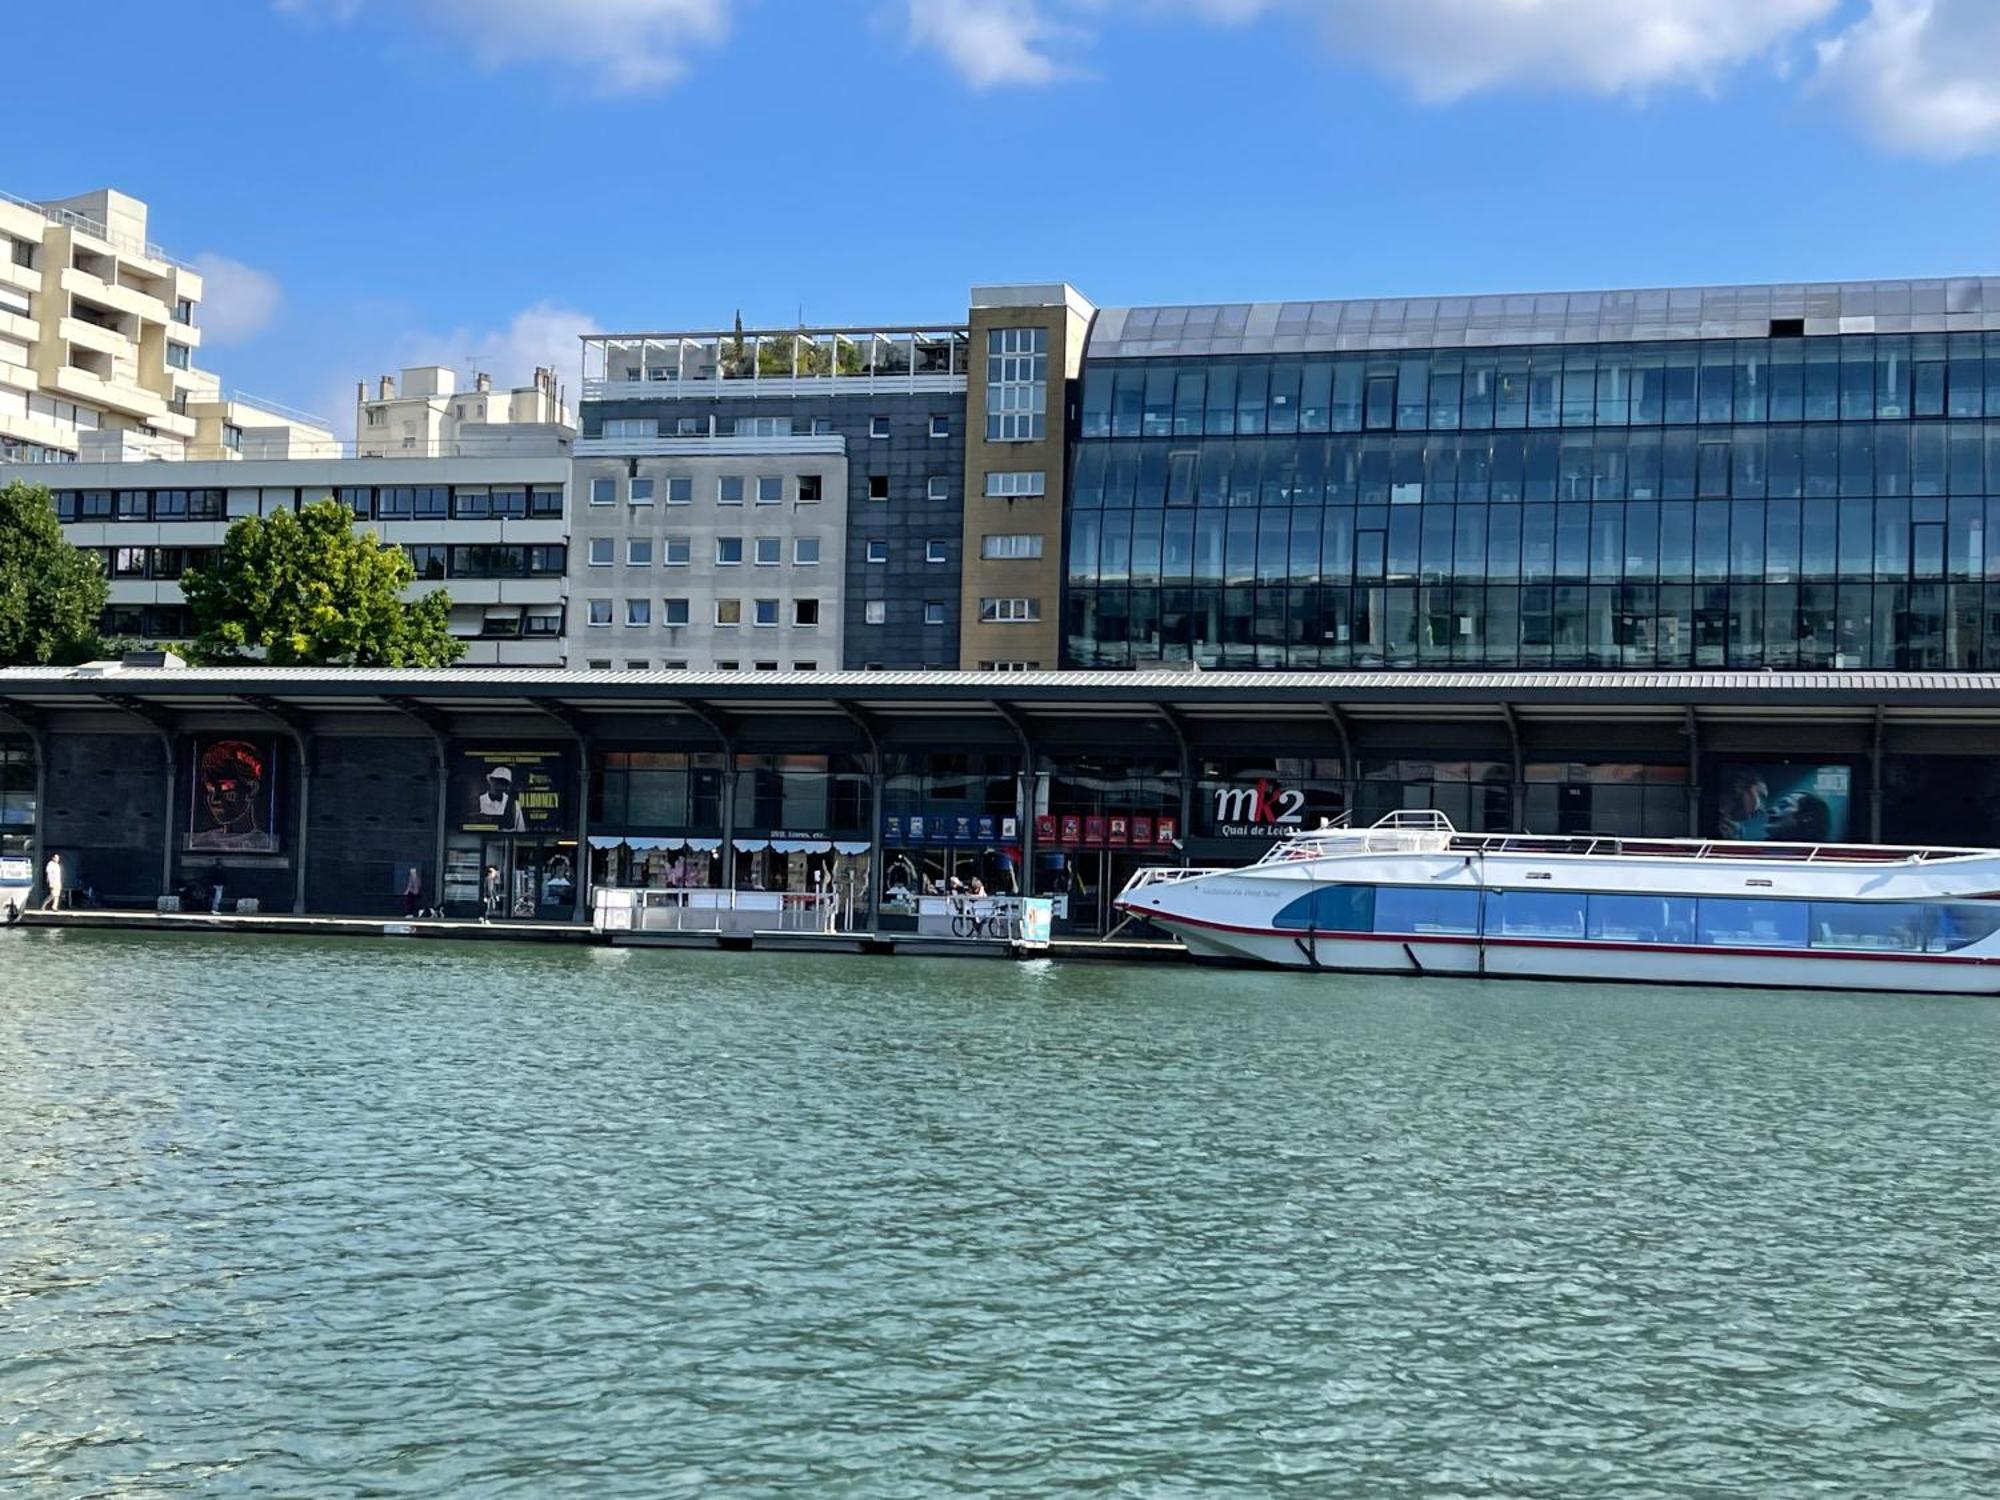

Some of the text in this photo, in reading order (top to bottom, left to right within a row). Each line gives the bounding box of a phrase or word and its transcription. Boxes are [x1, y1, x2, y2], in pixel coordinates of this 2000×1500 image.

[1215, 777, 1304, 823] mk2
[1222, 825, 1247, 836] Quai
[1250, 825, 1264, 836] de
